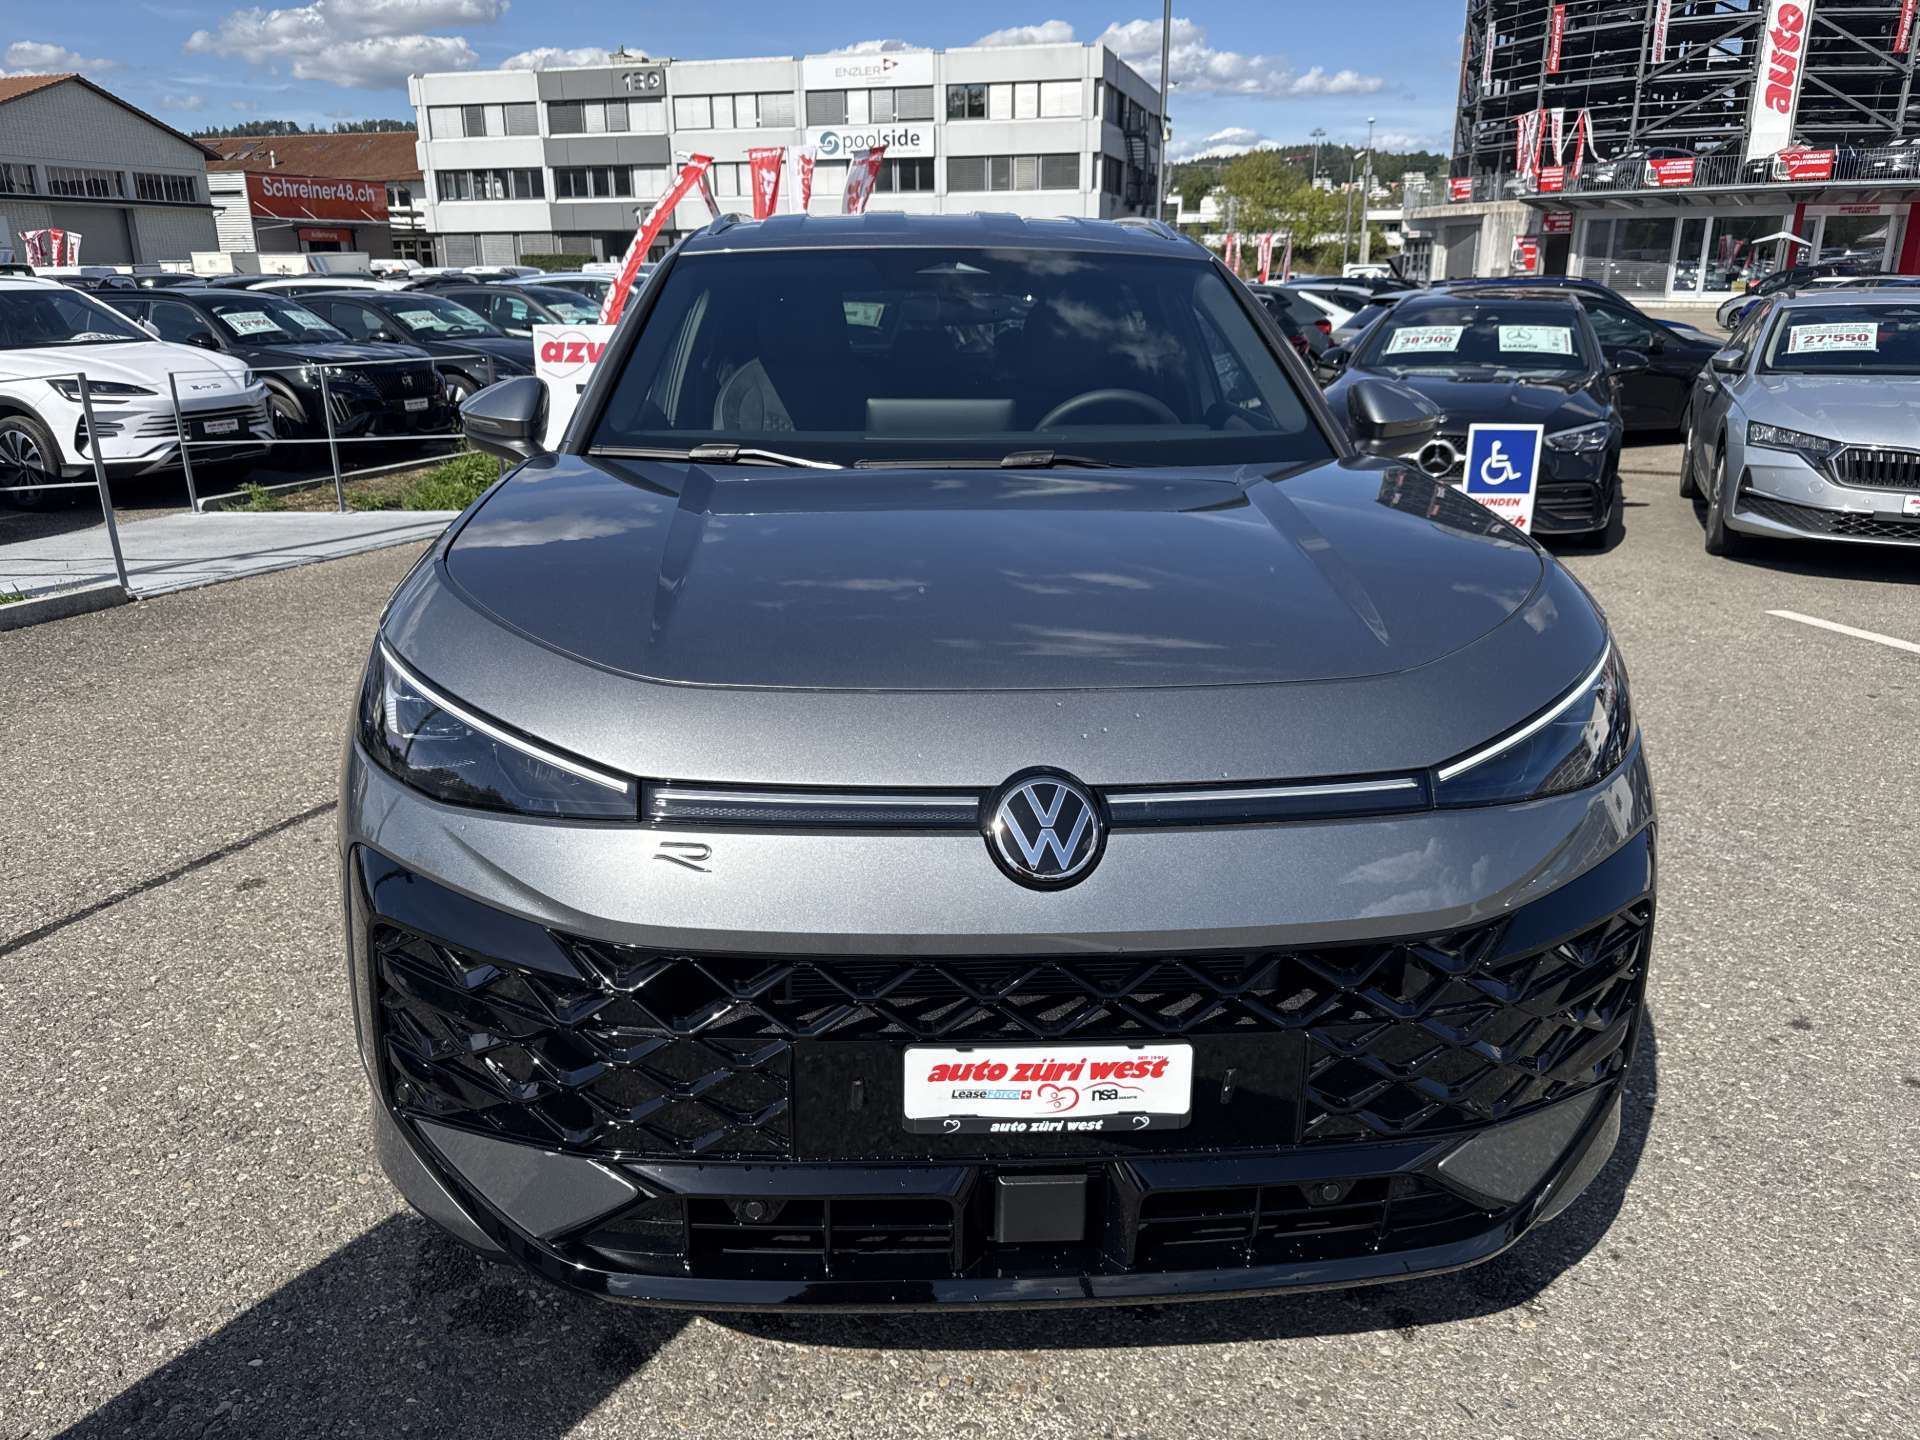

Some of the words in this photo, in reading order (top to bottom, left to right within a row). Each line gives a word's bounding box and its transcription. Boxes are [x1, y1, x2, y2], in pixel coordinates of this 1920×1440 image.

[1765, 3, 1804, 114] auto
[622, 71, 660, 92] 139
[835, 66, 881, 78] ENZLER
[843, 128, 920, 155] poolside
[262, 176, 375, 202] Schreiner48.ch
[598, 283, 616, 324] uto
[1803, 333, 1869, 344] 27'550
[927, 1060, 1009, 1082] auto
[1008, 1058, 1087, 1082] züri
[1089, 1056, 1169, 1079] west
[1092, 1088, 1118, 1101] nsa
[990, 1121, 1027, 1133] auto
[1030, 1120, 1064, 1132] züri
[1067, 1119, 1104, 1131] west
